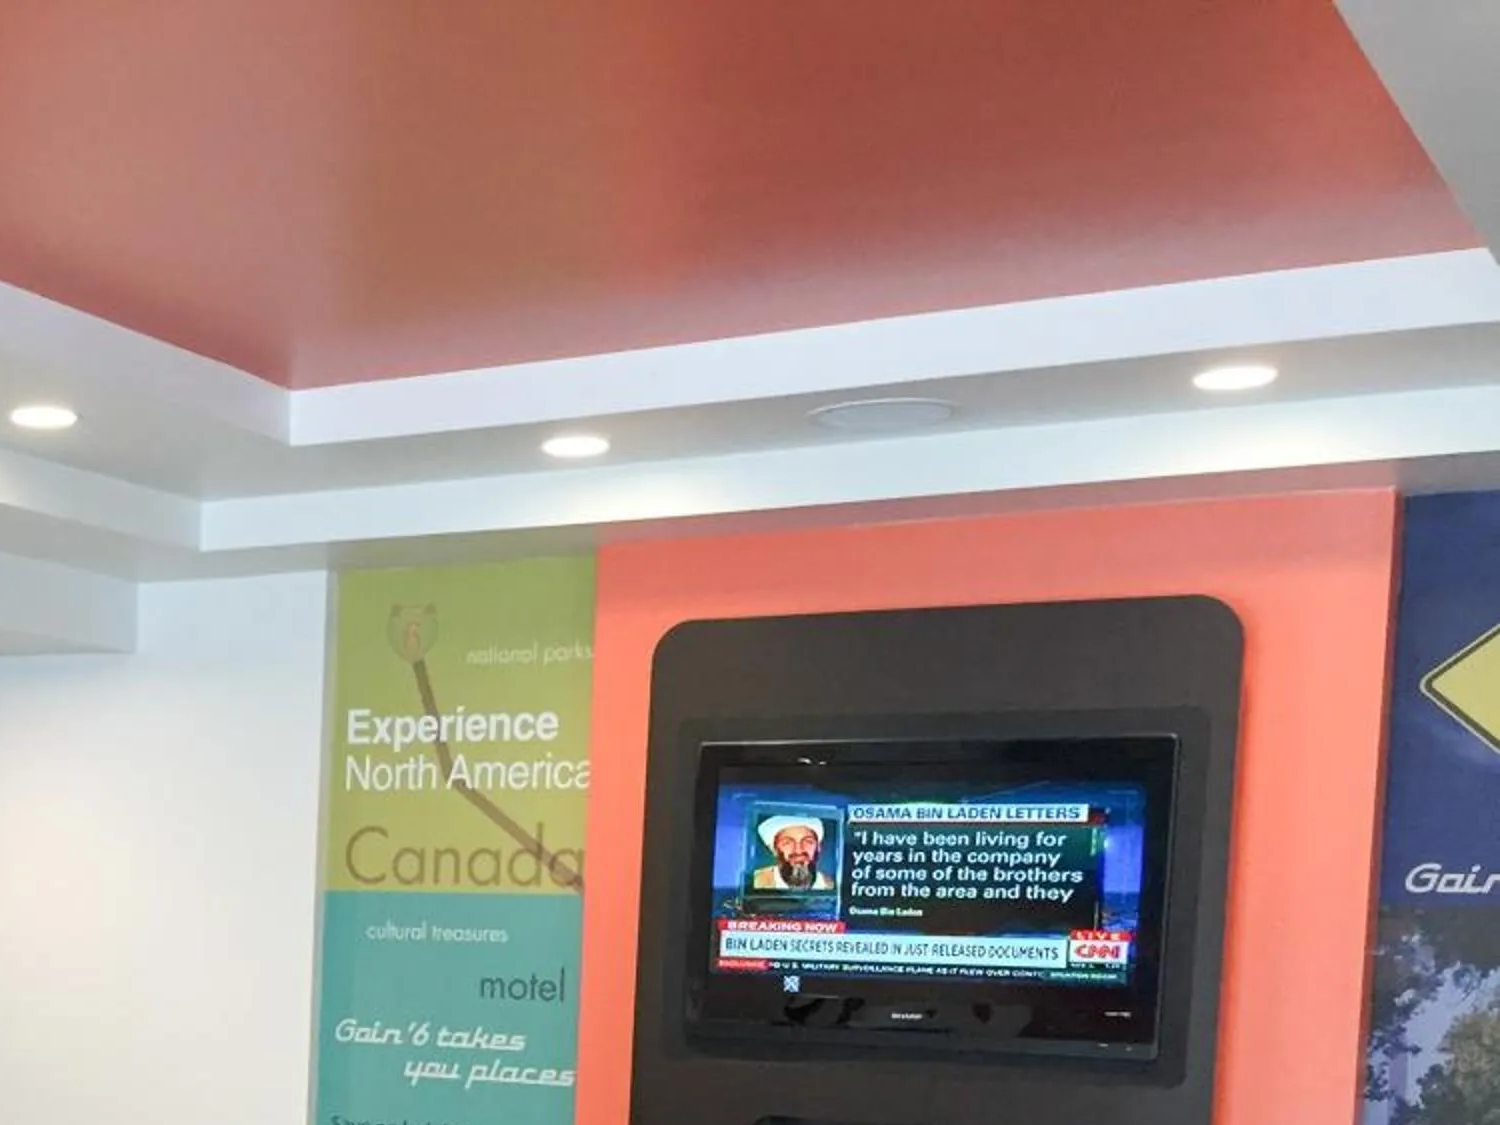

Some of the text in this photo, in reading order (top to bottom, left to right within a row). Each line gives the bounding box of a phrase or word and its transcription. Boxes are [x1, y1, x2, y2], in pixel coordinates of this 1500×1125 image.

[347, 706, 558, 753] Experience
[346, 755, 437, 791] North
[854, 807, 1080, 819] OSAMA BIN LADEN LETTERS
[872, 831, 917, 846] have
[923, 831, 969, 847] been
[975, 831, 1029, 849] living
[1036, 831, 1067, 847] for
[345, 821, 585, 886] Canada
[852, 848, 1060, 868] years in the company
[851, 865, 1084, 883] of some of the brothers
[851, 882, 1074, 903] from the area and they
[365, 920, 508, 943] cultural treasures
[728, 921, 838, 933] BREAKING NOW
[726, 938, 1059, 960] BIN LADEN SECRETS REVEALED IN JUST RELEASED DOCUMENTS
[1074, 943, 1122, 959] CNN
[480, 965, 565, 1003] motel
[436, 1025, 526, 1051] takes
[404, 1058, 576, 1090] you places
